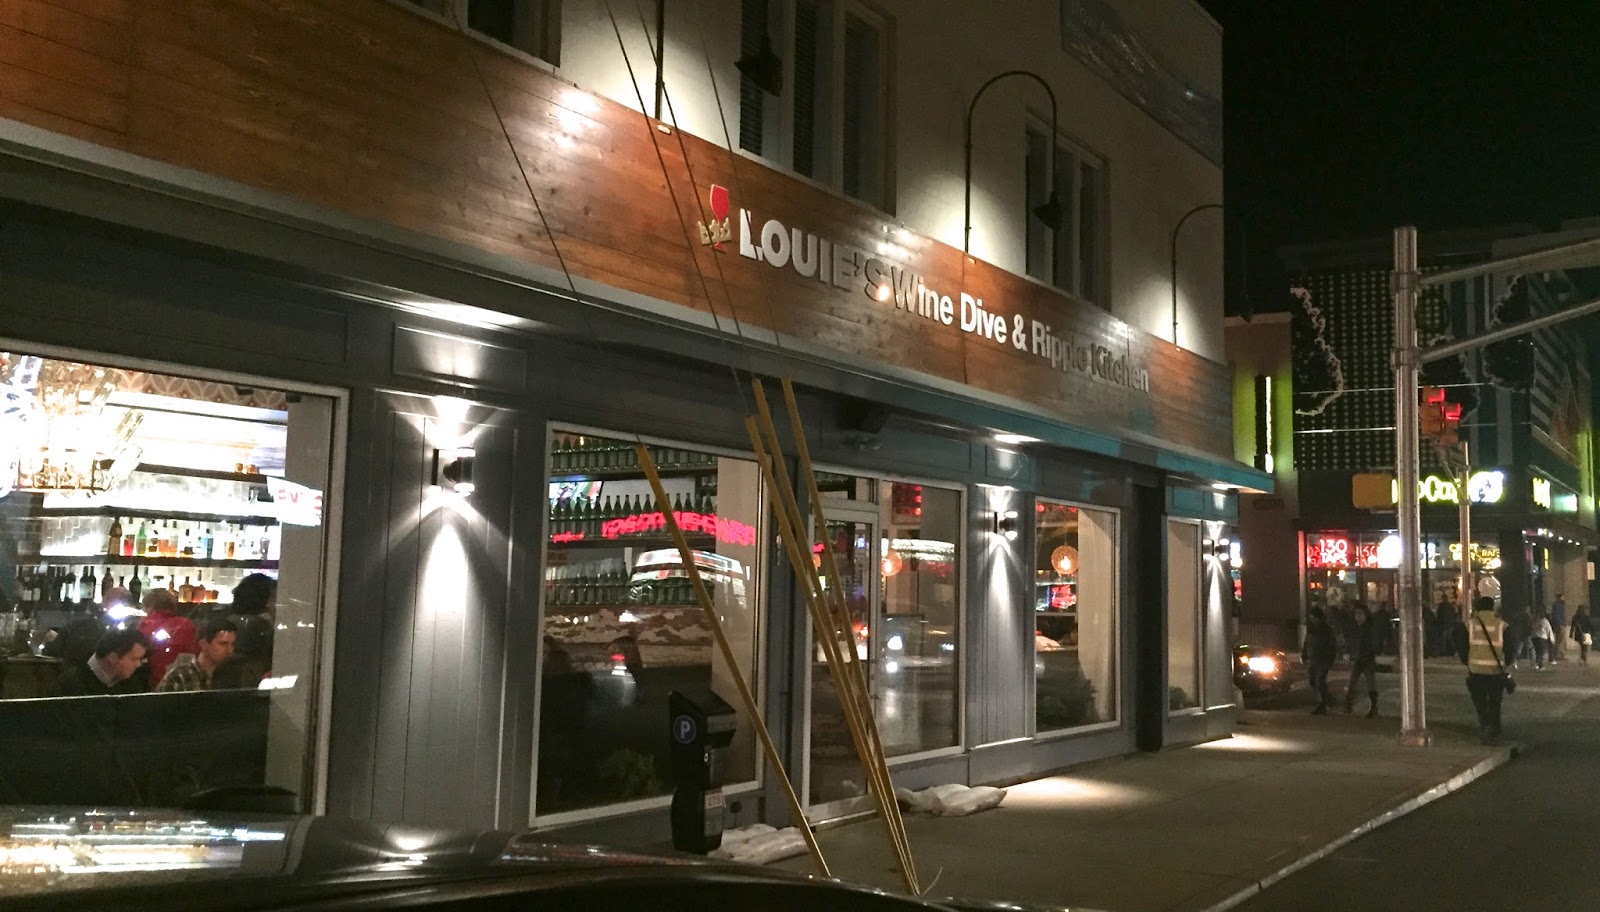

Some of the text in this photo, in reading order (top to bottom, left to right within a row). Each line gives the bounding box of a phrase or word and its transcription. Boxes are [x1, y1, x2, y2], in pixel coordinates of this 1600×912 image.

[740, 208, 1150, 394] LOUIE'S Wine Dive & Ripple Kitchen
[680, 720, 691, 740] P
